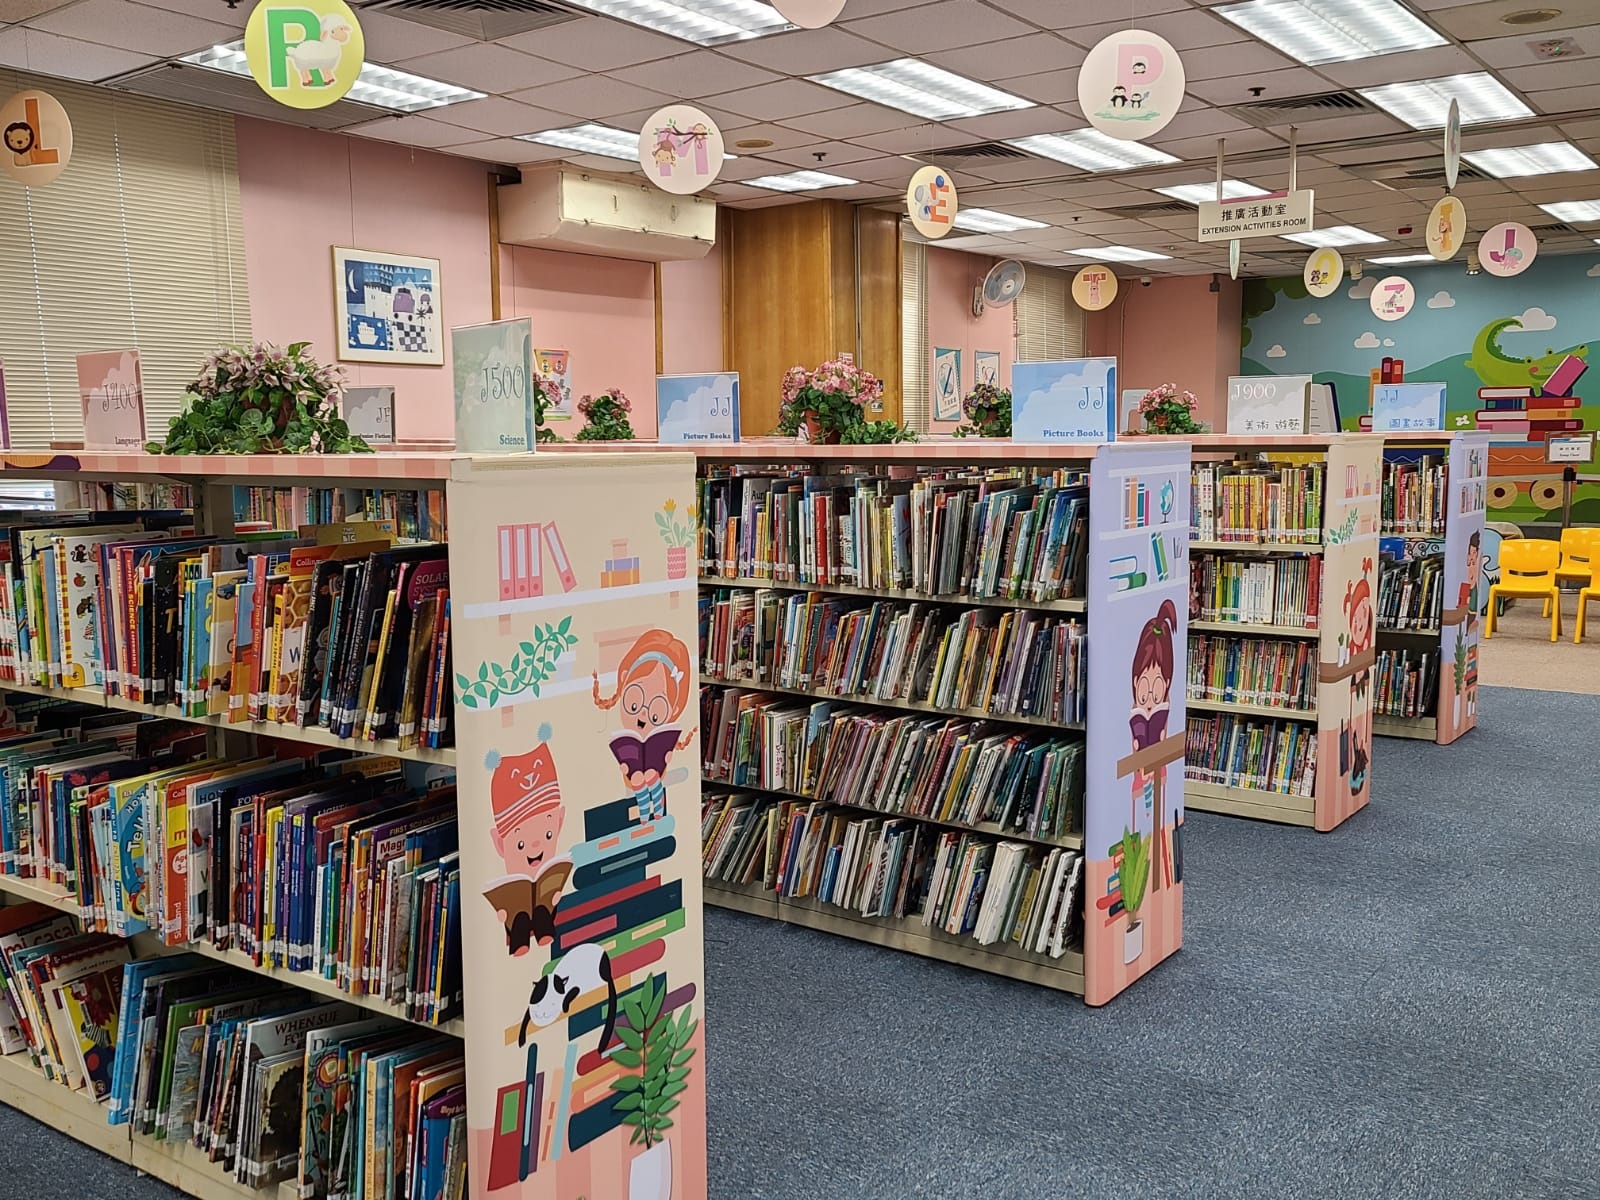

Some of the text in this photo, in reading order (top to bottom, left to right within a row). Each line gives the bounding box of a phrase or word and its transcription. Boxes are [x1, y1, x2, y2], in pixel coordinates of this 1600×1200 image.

[1116, 44, 1164, 108] P
[25, 98, 59, 166] L
[658, 127, 708, 176] M
[1221, 204, 1287, 222] 推廣活動室
[1202, 217, 1307, 235] EXTENSION ACTIVITIES ROOM
[1489, 229, 1516, 263] J
[481, 361, 525, 403] J500
[1231, 383, 1276, 400] J900
[102, 382, 138, 412] J400
[710, 397, 731, 416] JJ
[1079, 387, 1104, 409] JJ
[499, 434, 525, 445] Science
[1043, 429, 1104, 437] Picture Books
[296, 558, 318, 567] Collin
[127, 593, 135, 629] SCIENCE
[172, 790, 186, 798] Coll
[389, 825, 408, 836] FIRST
[34, 926, 74, 946] casa
[275, 1016, 314, 1035] WHEN
